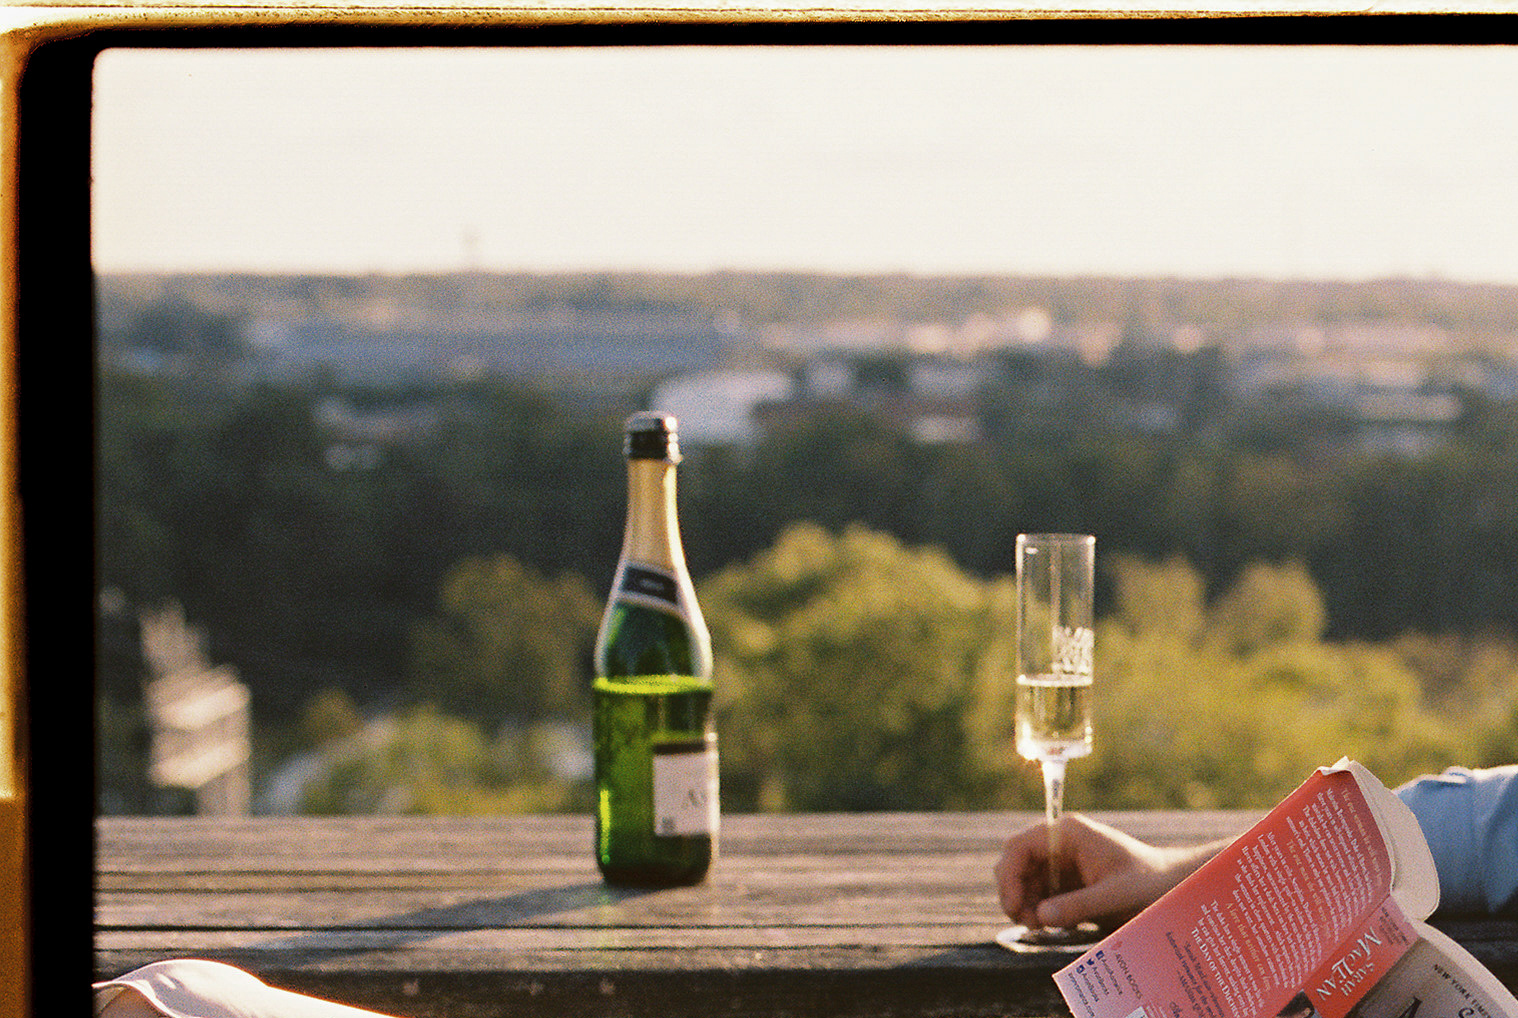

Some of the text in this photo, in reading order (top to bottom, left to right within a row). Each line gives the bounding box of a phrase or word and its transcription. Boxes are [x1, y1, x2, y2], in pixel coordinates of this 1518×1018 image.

[1301, 803, 1312, 818] The
[1256, 833, 1272, 856] London
[1233, 871, 1243, 883] the
[1239, 862, 1250, 874] she
[1251, 883, 1261, 896] her
[1240, 844, 1255, 864] Haven
[1249, 860, 1263, 879] offers
[1257, 875, 1268, 887] her
[1231, 887, 1243, 903] does
[1196, 916, 1207, 927] he
[1200, 902, 1211, 915] and
[1217, 934, 1228, 947] her
[1201, 925, 1210, 937] can
[1208, 898, 1220, 913] The
[1215, 910, 1227, 926] duke
[1222, 922, 1233, 935] has
[1228, 936, 1243, 955] single
[1205, 934, 1217, 948] give
[1212, 944, 1222, 957] her
[1224, 899, 1266, 976] A love that neither can
[1113, 950, 1144, 1001] AVON BOOKS
[1198, 942, 1214, 963] DAY
[1213, 970, 1225, 987] THE
[1432, 963, 1450, 981] NEW
[1450, 978, 1471, 1000] YORK
